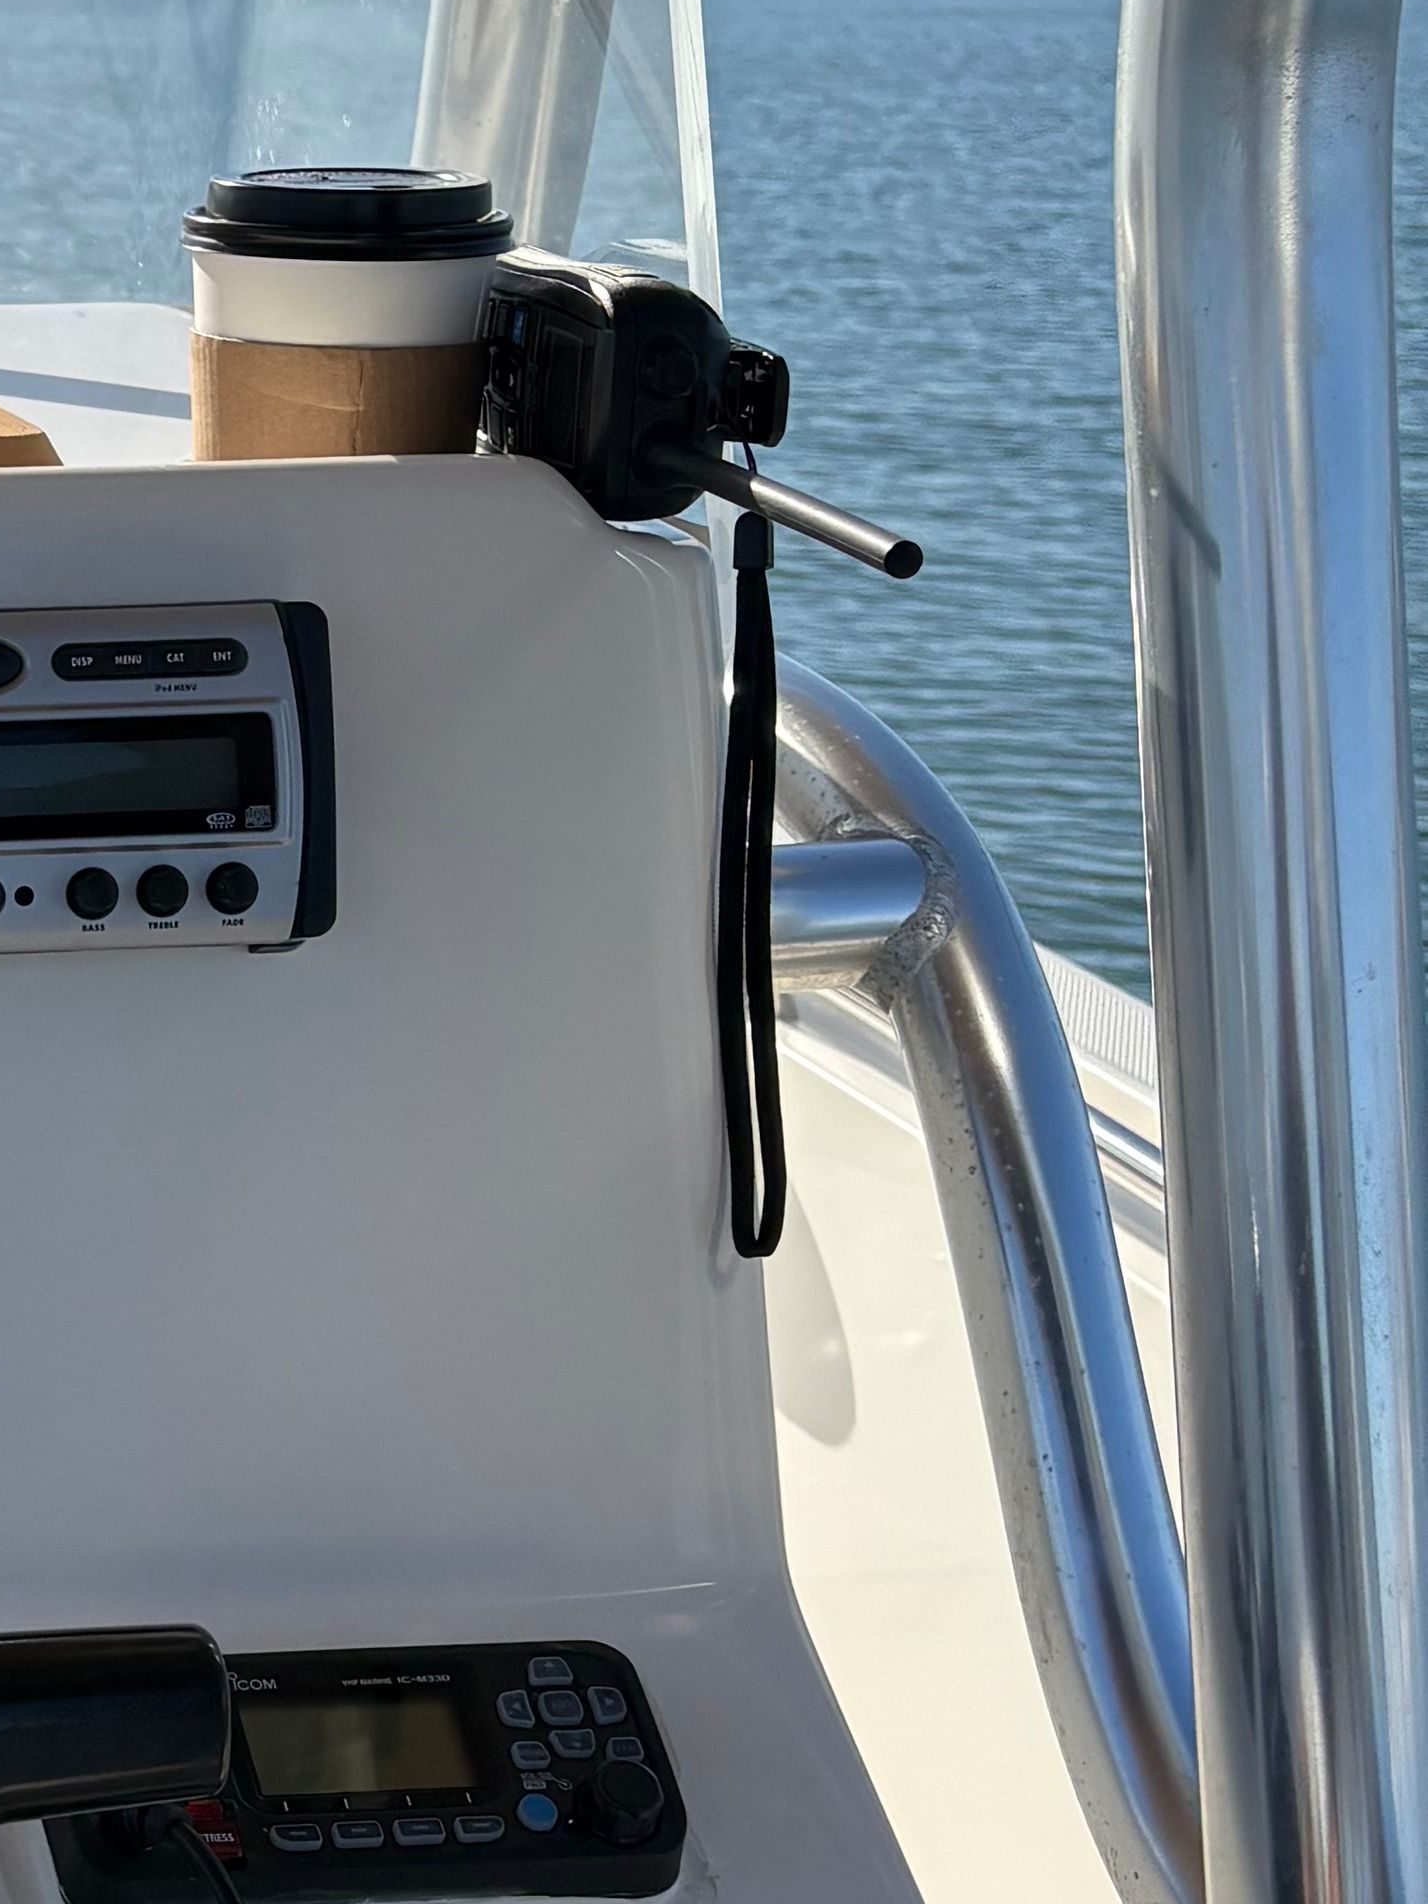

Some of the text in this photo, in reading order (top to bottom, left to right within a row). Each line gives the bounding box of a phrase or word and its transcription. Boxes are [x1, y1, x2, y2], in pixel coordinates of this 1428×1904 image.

[70, 655, 94, 670] DISP
[114, 653, 143, 668] MENU
[165, 651, 186, 666] CAT
[212, 650, 233, 663] ENT
[148, 921, 180, 930] TREBLE
[221, 918, 245, 927] FADE
